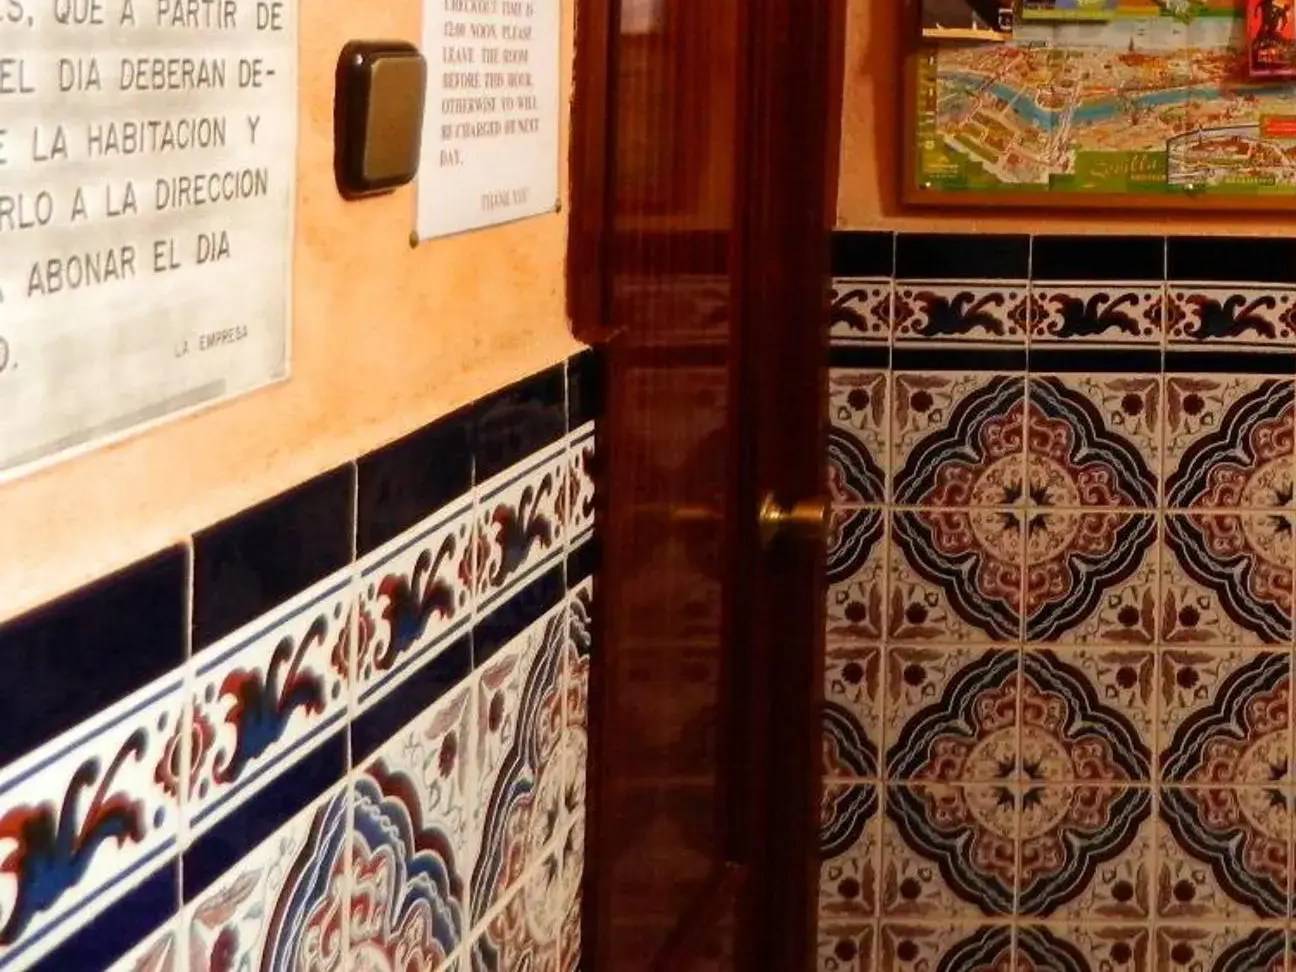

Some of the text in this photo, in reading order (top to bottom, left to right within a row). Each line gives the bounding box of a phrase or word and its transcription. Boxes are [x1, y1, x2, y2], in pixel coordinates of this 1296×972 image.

[256, 2, 283, 30] DE
[59, 58, 102, 92] DIA
[120, 59, 226, 91] DEBERAN
[238, 58, 276, 88] DE-
[33, 126, 68, 162] LA
[88, 116, 227, 158] HABITACION
[249, 116, 260, 145] Y
[70, 186, 88, 222] A
[106, 180, 138, 217] LA
[155, 168, 269, 210] DIRECCION
[27, 230, 231, 298] ABONAR EL DIA
[174, 325, 249, 358] LA EMPRESA
